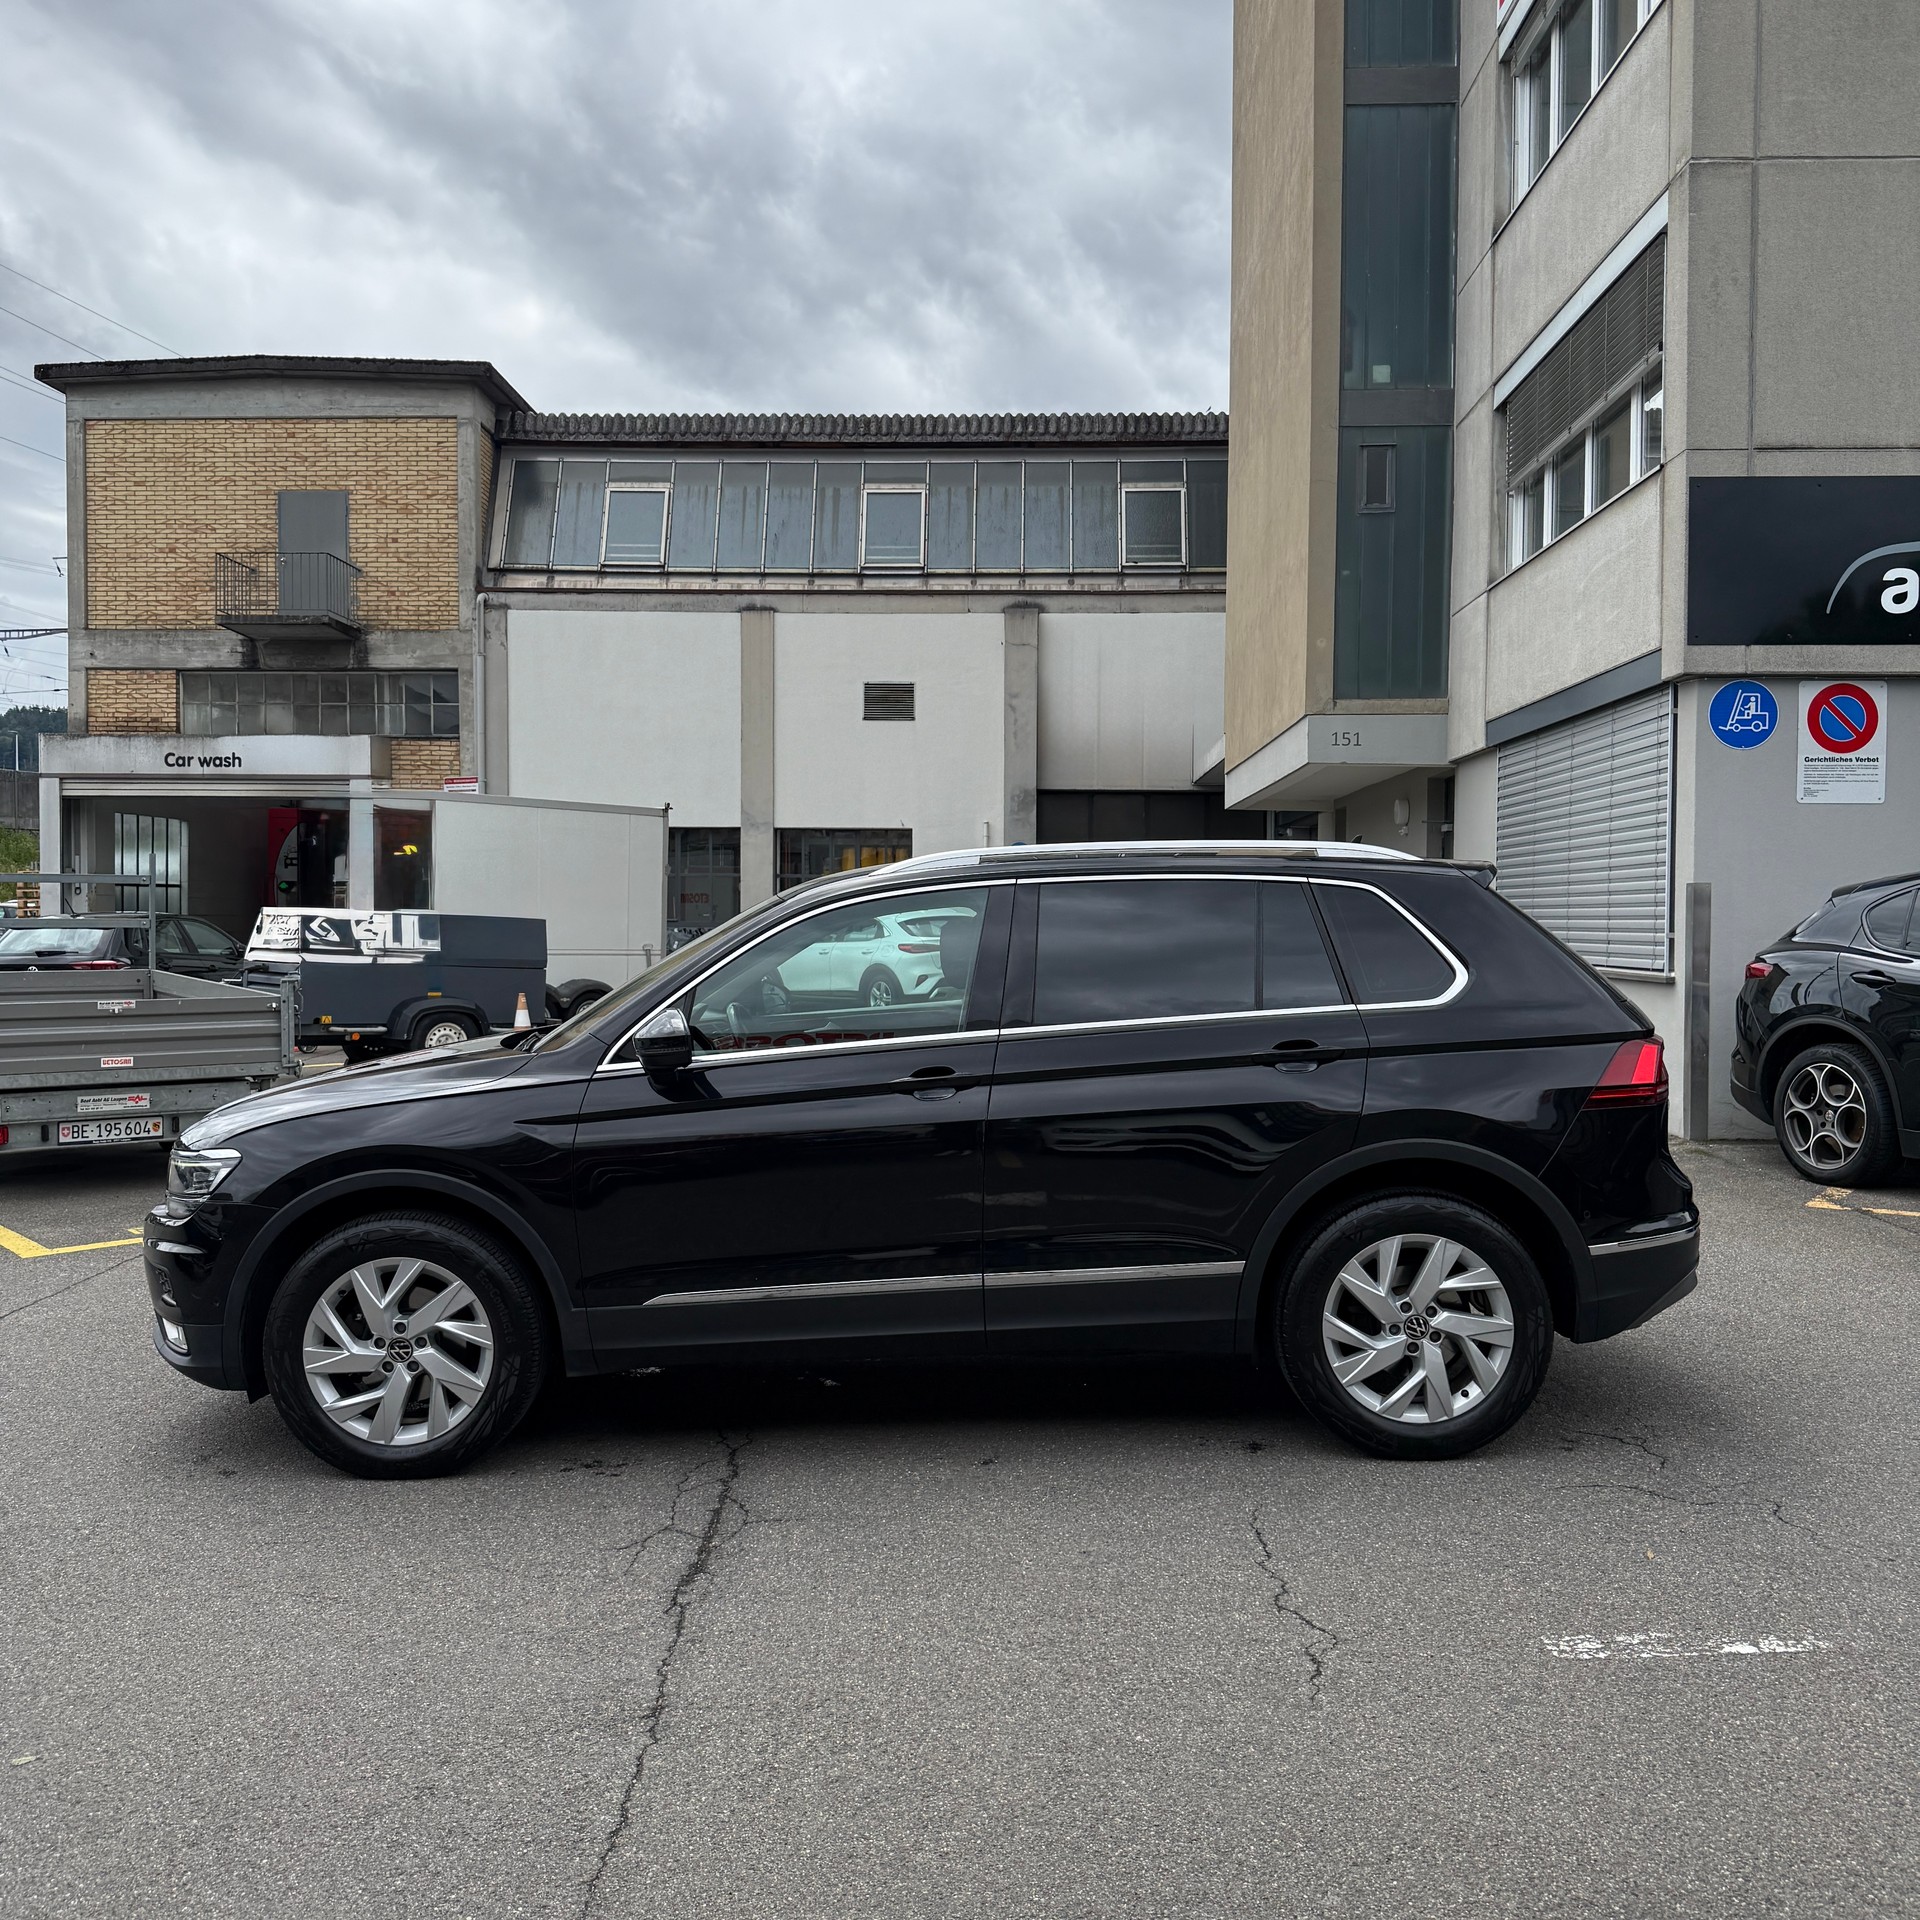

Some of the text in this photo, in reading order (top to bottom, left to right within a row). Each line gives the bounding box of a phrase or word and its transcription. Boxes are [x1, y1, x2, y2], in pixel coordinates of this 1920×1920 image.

[1880, 567, 1919, 614] a
[1331, 731, 1362, 746] 151
[164, 752, 242, 767] Car wash
